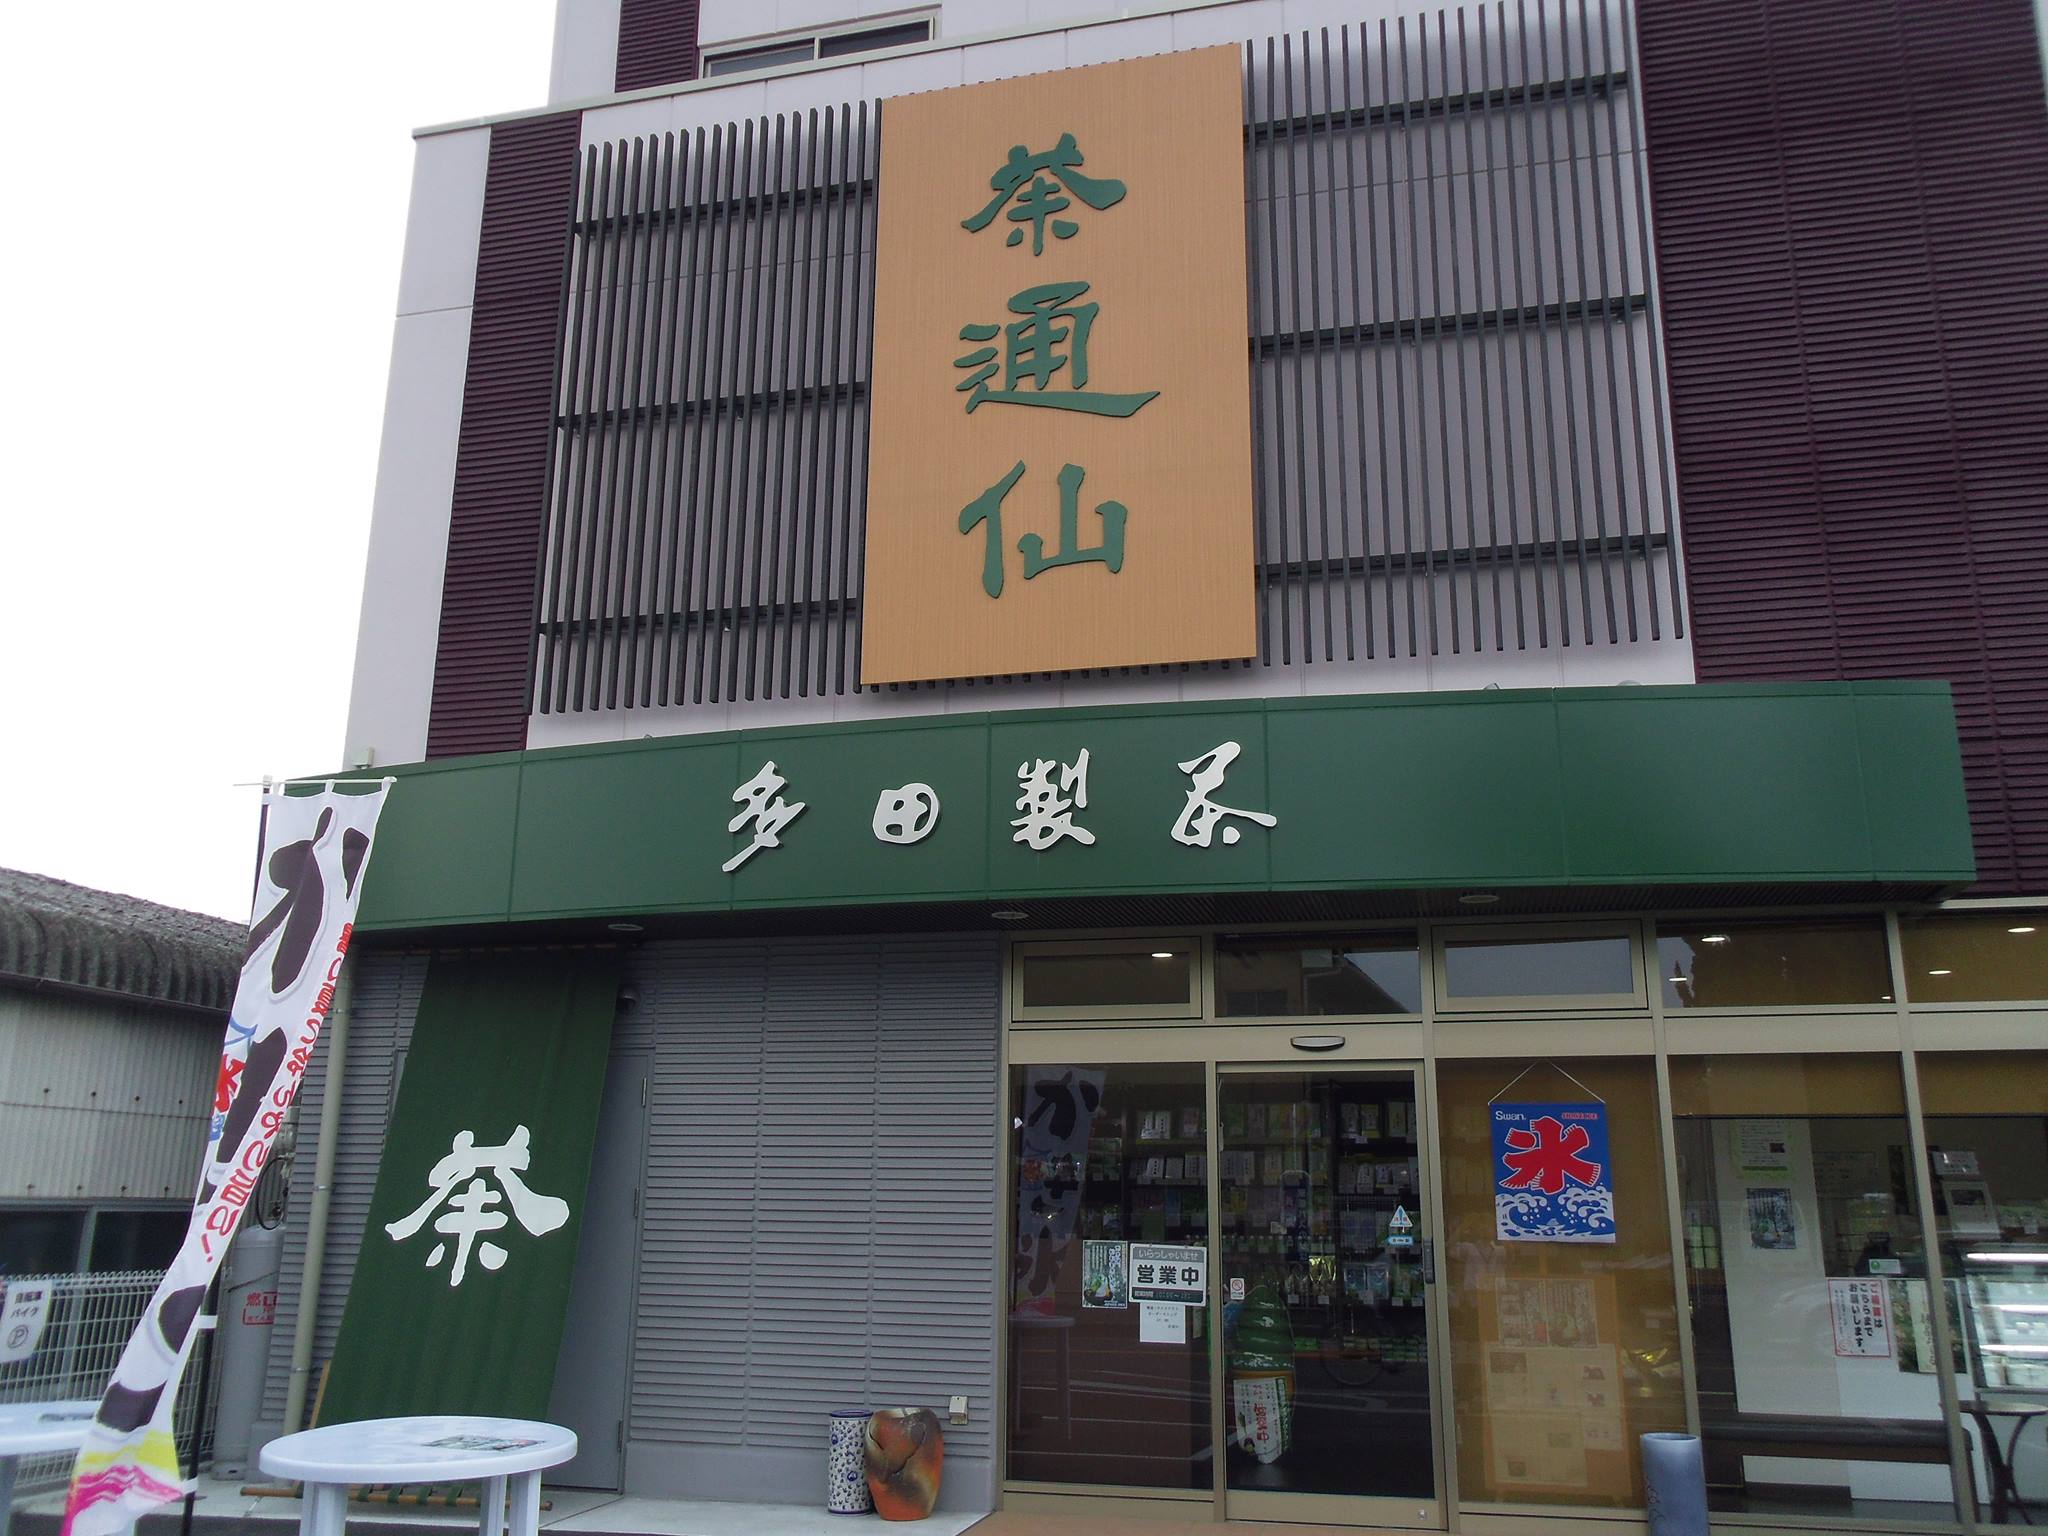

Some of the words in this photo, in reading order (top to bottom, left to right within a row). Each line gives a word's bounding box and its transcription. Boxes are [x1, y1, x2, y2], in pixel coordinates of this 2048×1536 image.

[954, 132, 1160, 598] 茶通仙
[1499, 1116, 1601, 1195] 氷
[384, 1124, 570, 1287] 茶
[1137, 1264, 1199, 1286] 営業中
[1138, 1249, 1199, 1261] いらっしゃいませ
[1860, 1283, 1873, 1336] こちらまで
